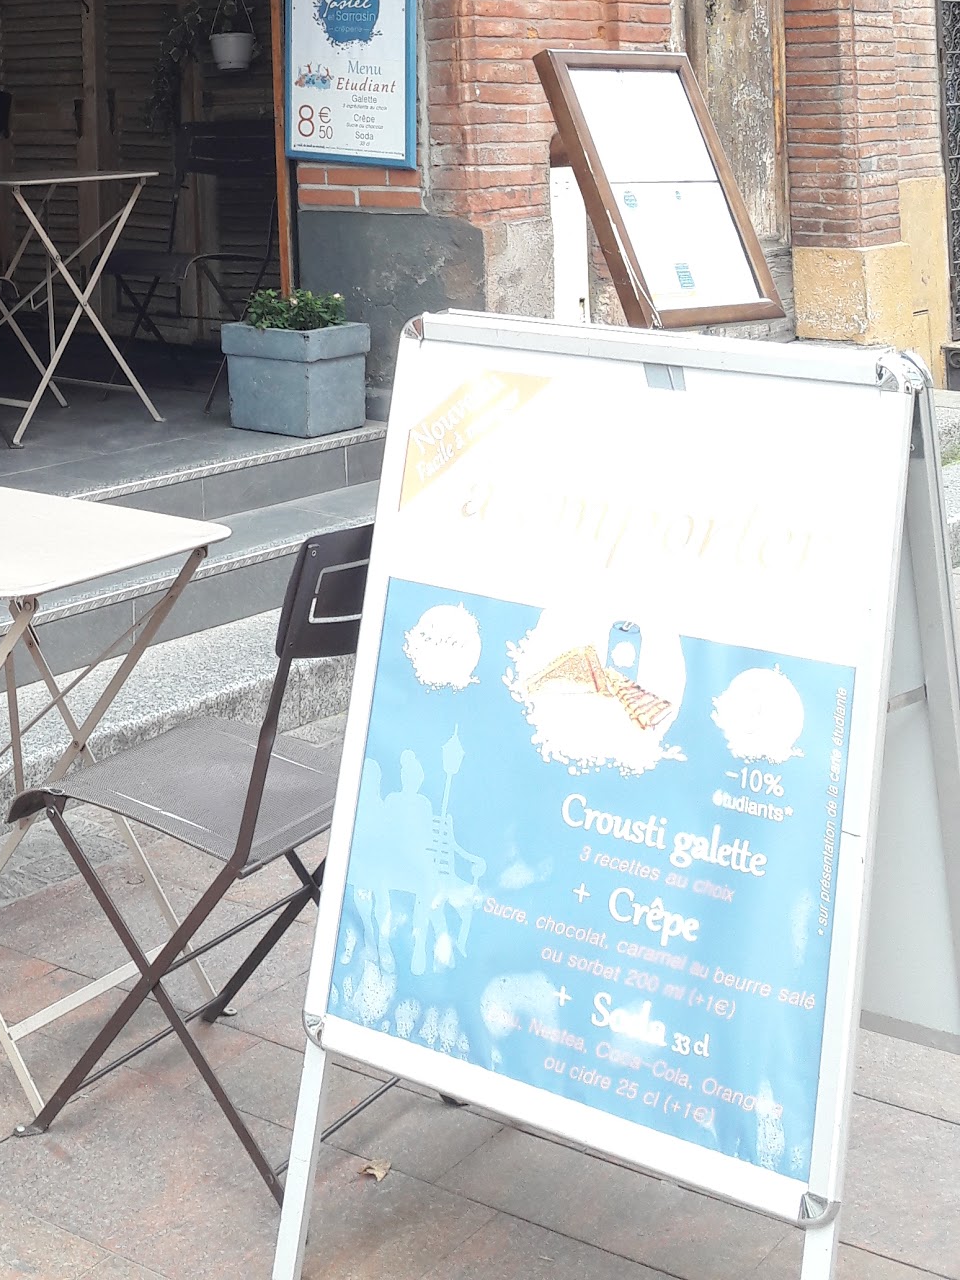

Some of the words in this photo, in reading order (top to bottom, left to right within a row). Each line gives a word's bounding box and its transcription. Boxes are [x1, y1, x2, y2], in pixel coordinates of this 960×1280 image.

[335, 10, 377, 21] Sarrasin
[347, 60, 383, 76] Menu
[336, 76, 397, 94] Etudiant
[351, 94, 378, 104] Galette
[298, 104, 315, 138] 8
[318, 125, 334, 140] 50
[353, 113, 376, 123] Crêpe
[355, 130, 374, 141] Soda
[554, 494, 832, 574] mporter
[831, 686, 848, 748] étudiante
[724, 767, 785, 797] -10%
[826, 782, 839, 799] la
[825, 798, 838, 819] de
[561, 793, 668, 850] Crousti
[669, 823, 768, 877] galette
[578, 845, 592, 862] 3
[593, 852, 661, 880] recettes
[664, 872, 689, 889] au
[692, 878, 735, 902] choix
[817, 819, 836, 904] présentation
[608, 886, 700, 947] Crêpe
[817, 902, 830, 927] sur
[540, 946, 563, 964] ou
[567, 949, 621, 982] sorbet
[624, 970, 660, 993] 200
[616, 938, 689, 971] caramel
[713, 966, 773, 997] beurre
[777, 984, 816, 1010] salé
[670, 1031, 691, 1056] 33
[693, 1033, 711, 1058] cl
[543, 1056, 566, 1074] ou
[569, 1063, 611, 1091] cidre
[615, 1078, 639, 1100] 25
[642, 1090, 660, 1108] cl
[701, 1076, 785, 1119] Oranga
